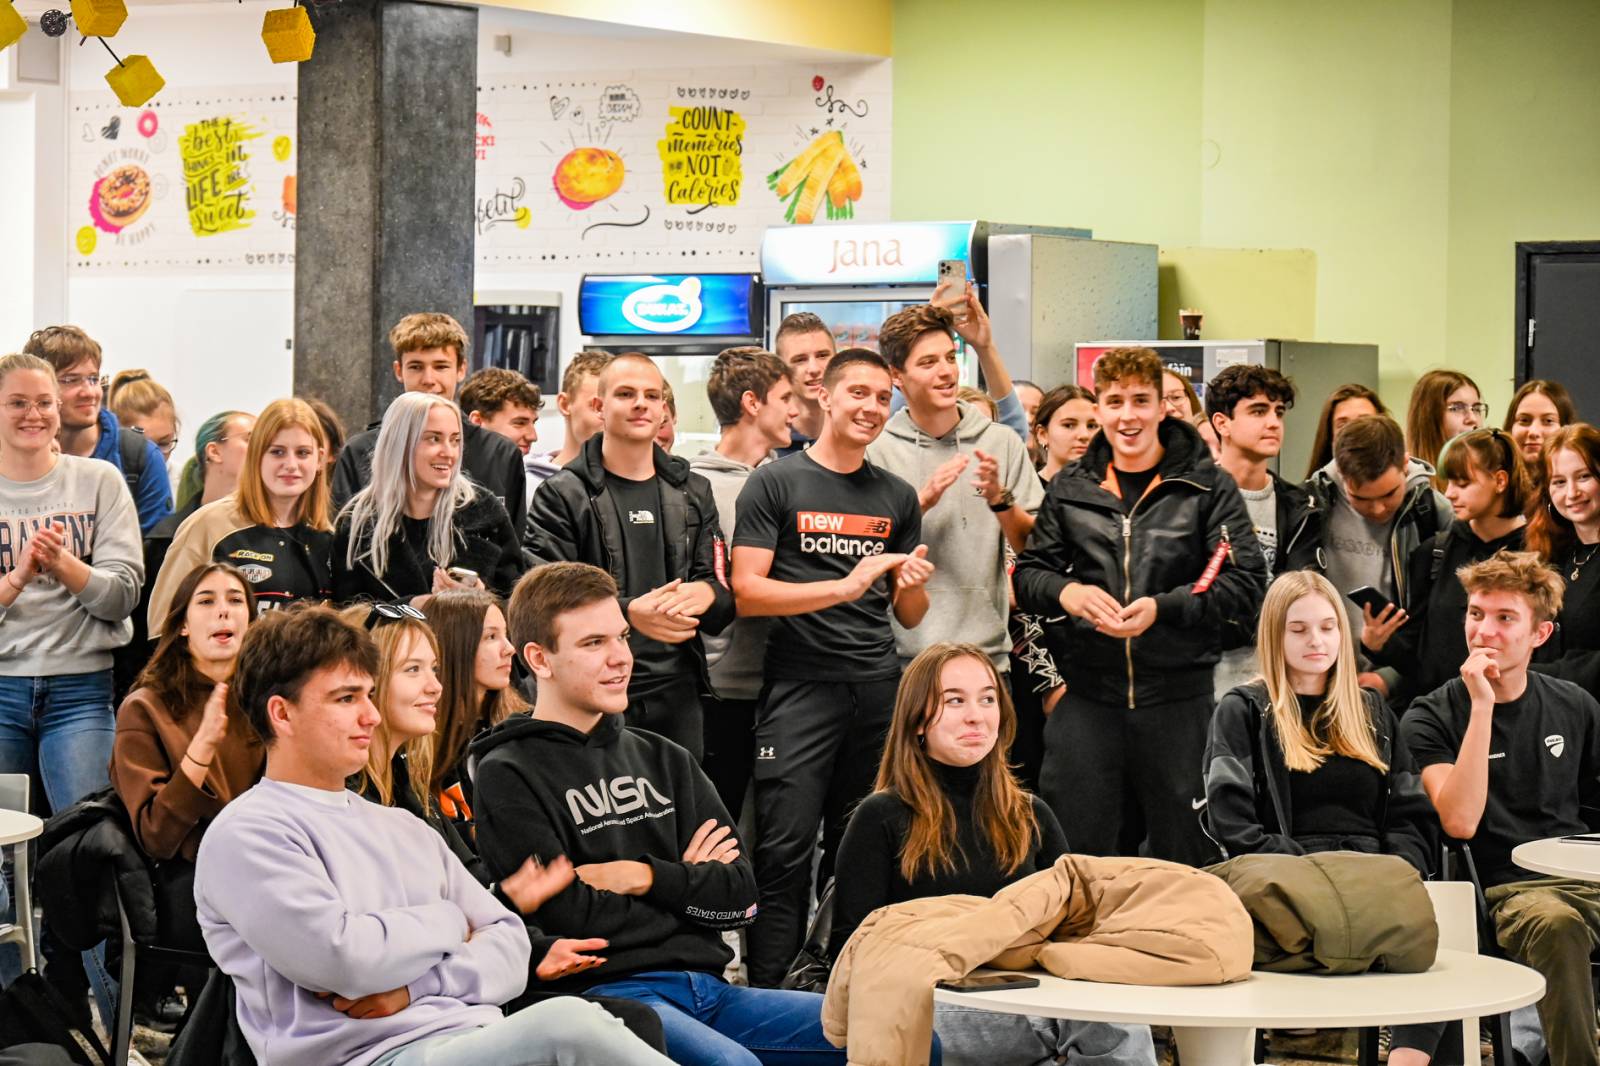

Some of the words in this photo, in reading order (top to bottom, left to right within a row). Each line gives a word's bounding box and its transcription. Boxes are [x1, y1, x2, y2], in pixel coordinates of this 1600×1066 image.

[682, 106, 734, 131] COUNT
[667, 132, 743, 156] memories
[685, 154, 722, 177] NOT
[186, 168, 222, 211] LIFE
[800, 512, 844, 532] new
[800, 533, 885, 557] balance
[565, 776, 672, 825] NASA
[580, 822, 604, 835] National
[625, 814, 644, 825] Space
[686, 905, 716, 920] STATES
[717, 910, 746, 920] UNITED
